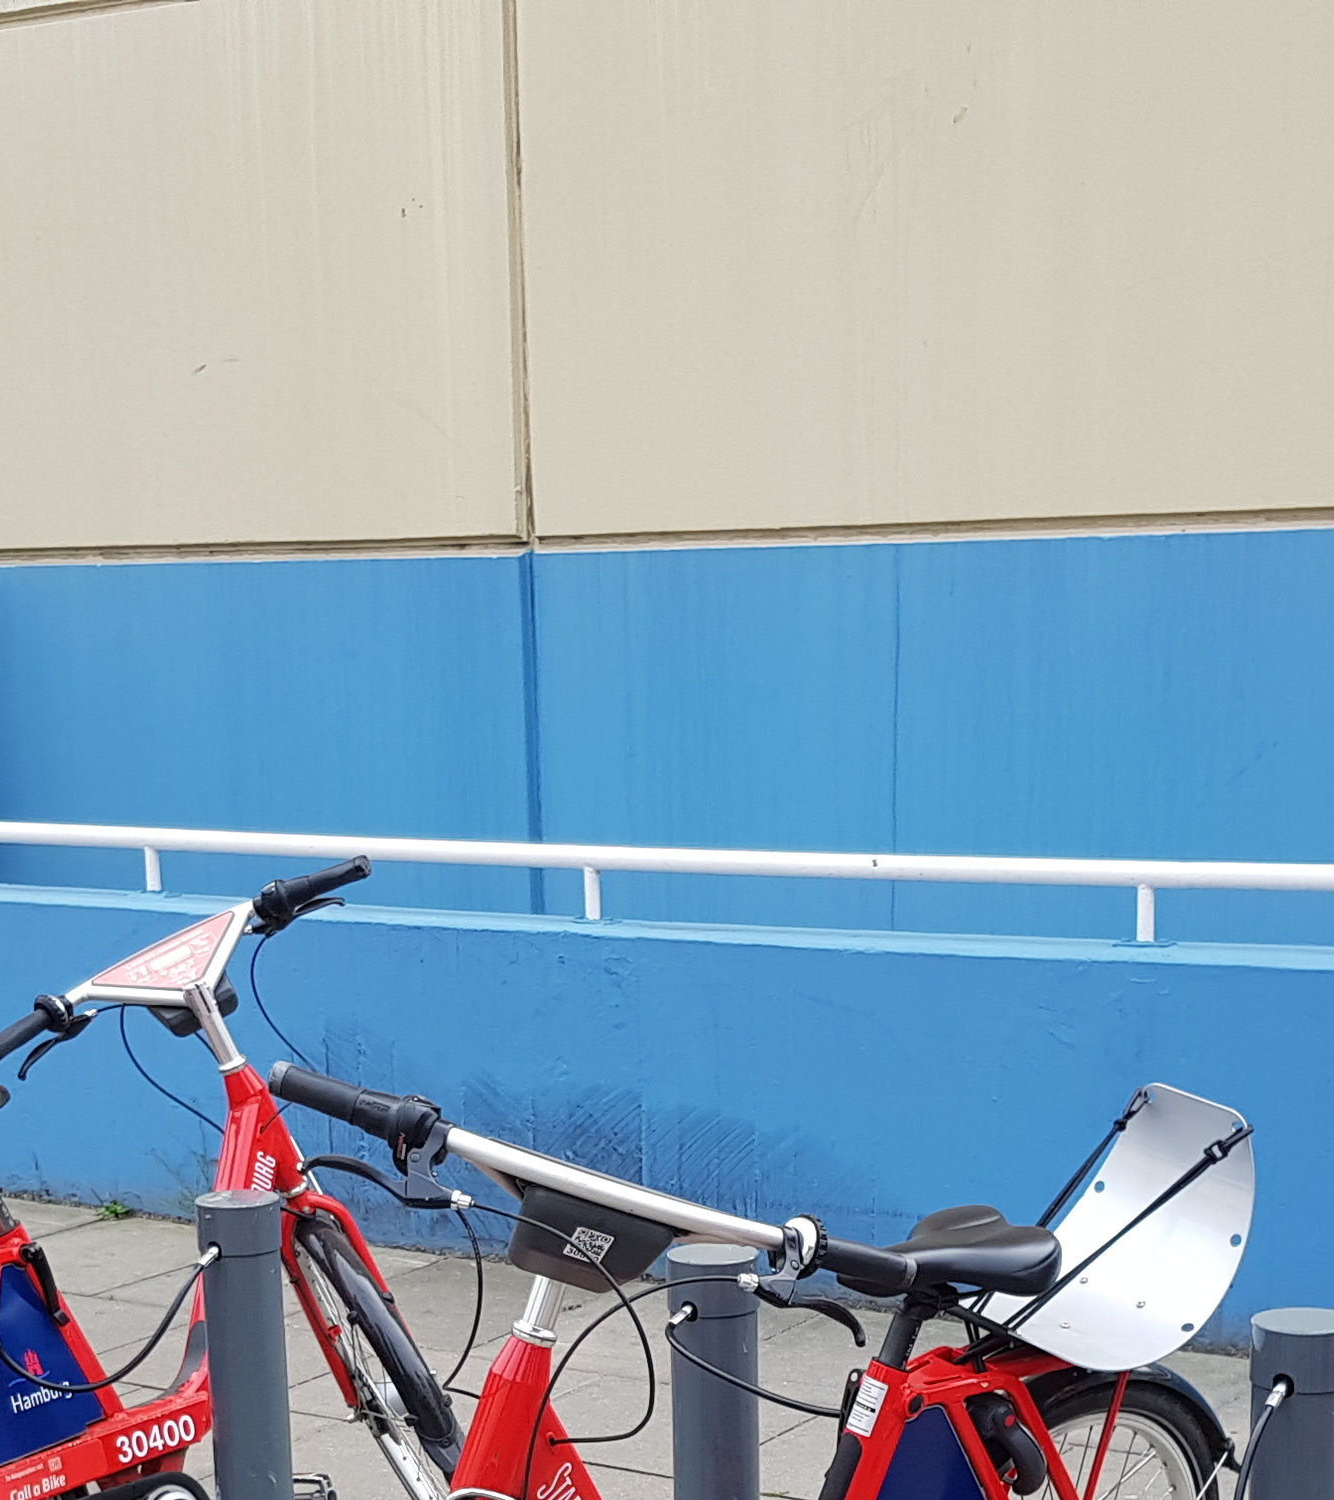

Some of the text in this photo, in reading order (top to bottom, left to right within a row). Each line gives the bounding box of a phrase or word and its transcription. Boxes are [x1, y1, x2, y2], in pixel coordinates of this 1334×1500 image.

[116, 1415, 195, 1463] 30400
[33, 1486, 41, 1497] a
[43, 1474, 66, 1494] Bike
